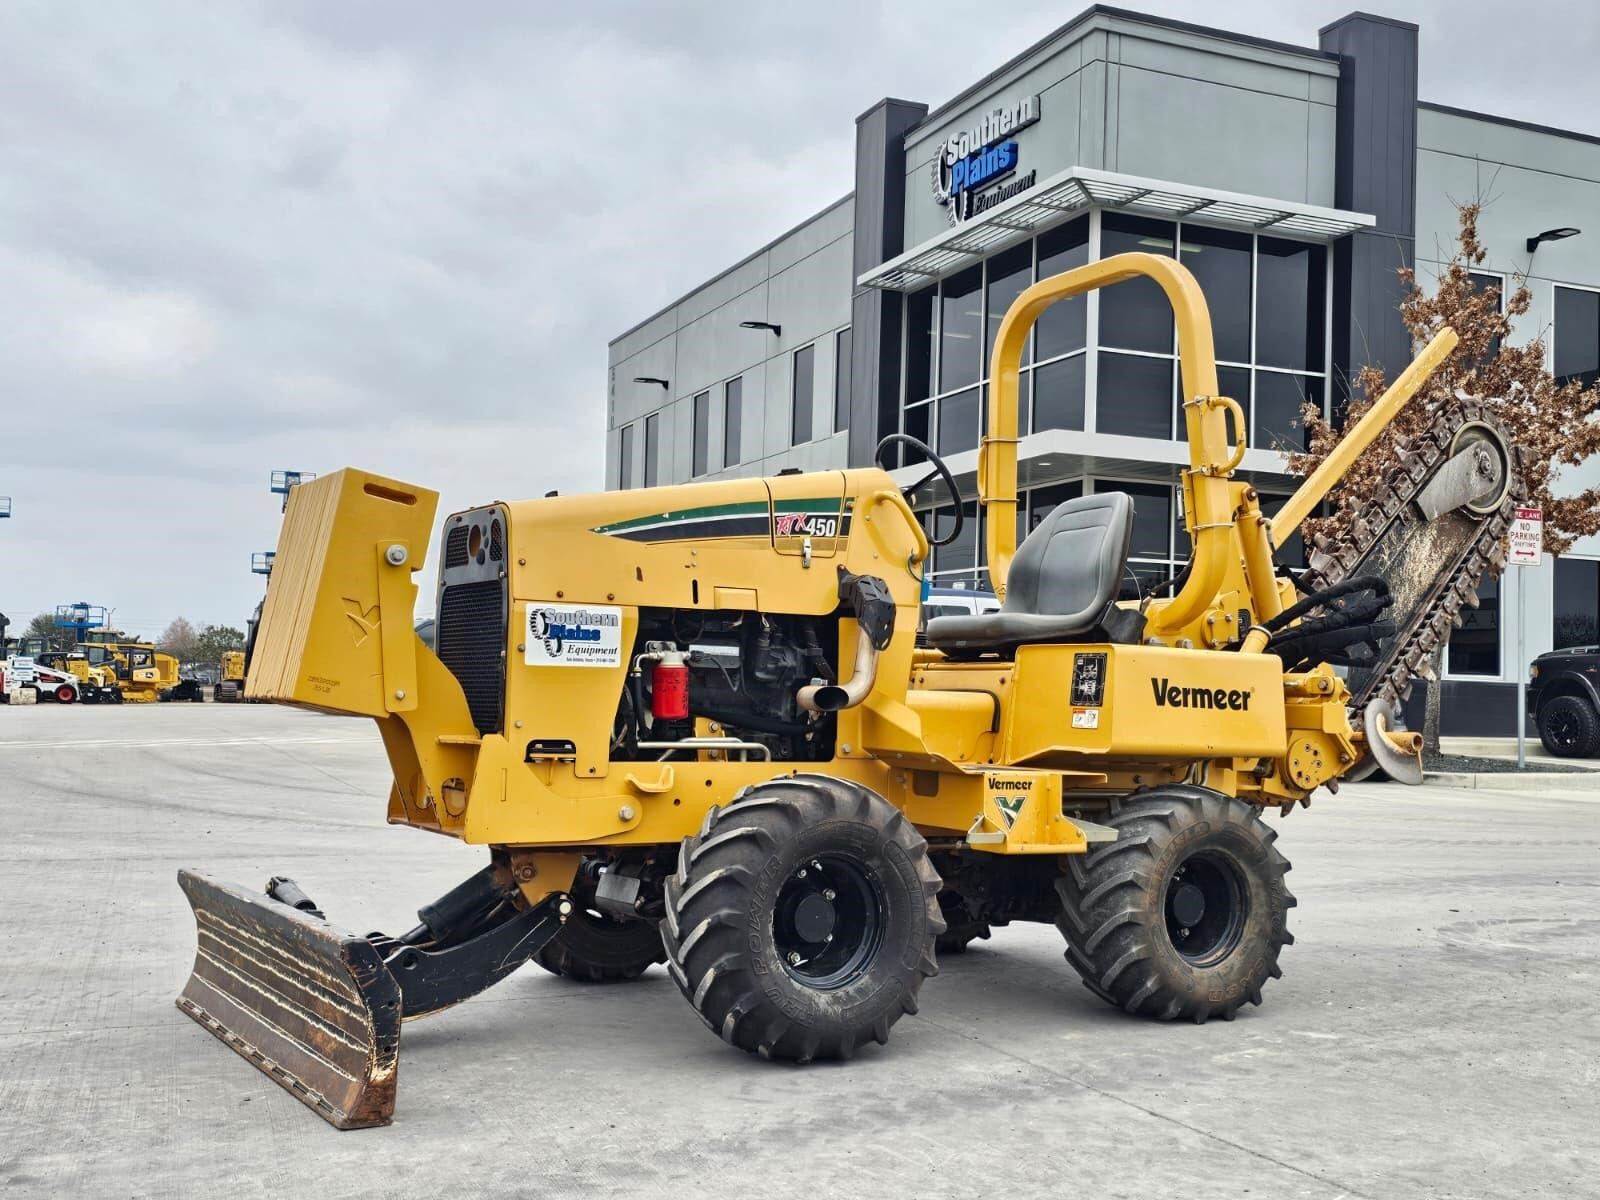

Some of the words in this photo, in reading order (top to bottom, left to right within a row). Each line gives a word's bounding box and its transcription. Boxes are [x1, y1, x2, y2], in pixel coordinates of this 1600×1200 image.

[946, 95, 1037, 166] Southern
[951, 138, 1016, 195] Plains
[973, 169, 1036, 214] Equipment
[1519, 522, 1531, 531] NO
[1510, 532, 1539, 541] PARKING
[1514, 541, 1537, 549] ANYTIME
[544, 607, 619, 627] Southern
[549, 622, 601, 641] Plains
[567, 644, 618, 657] Equipment
[1151, 677, 1251, 711] Vermeer
[988, 777, 1033, 790] Vermeer
